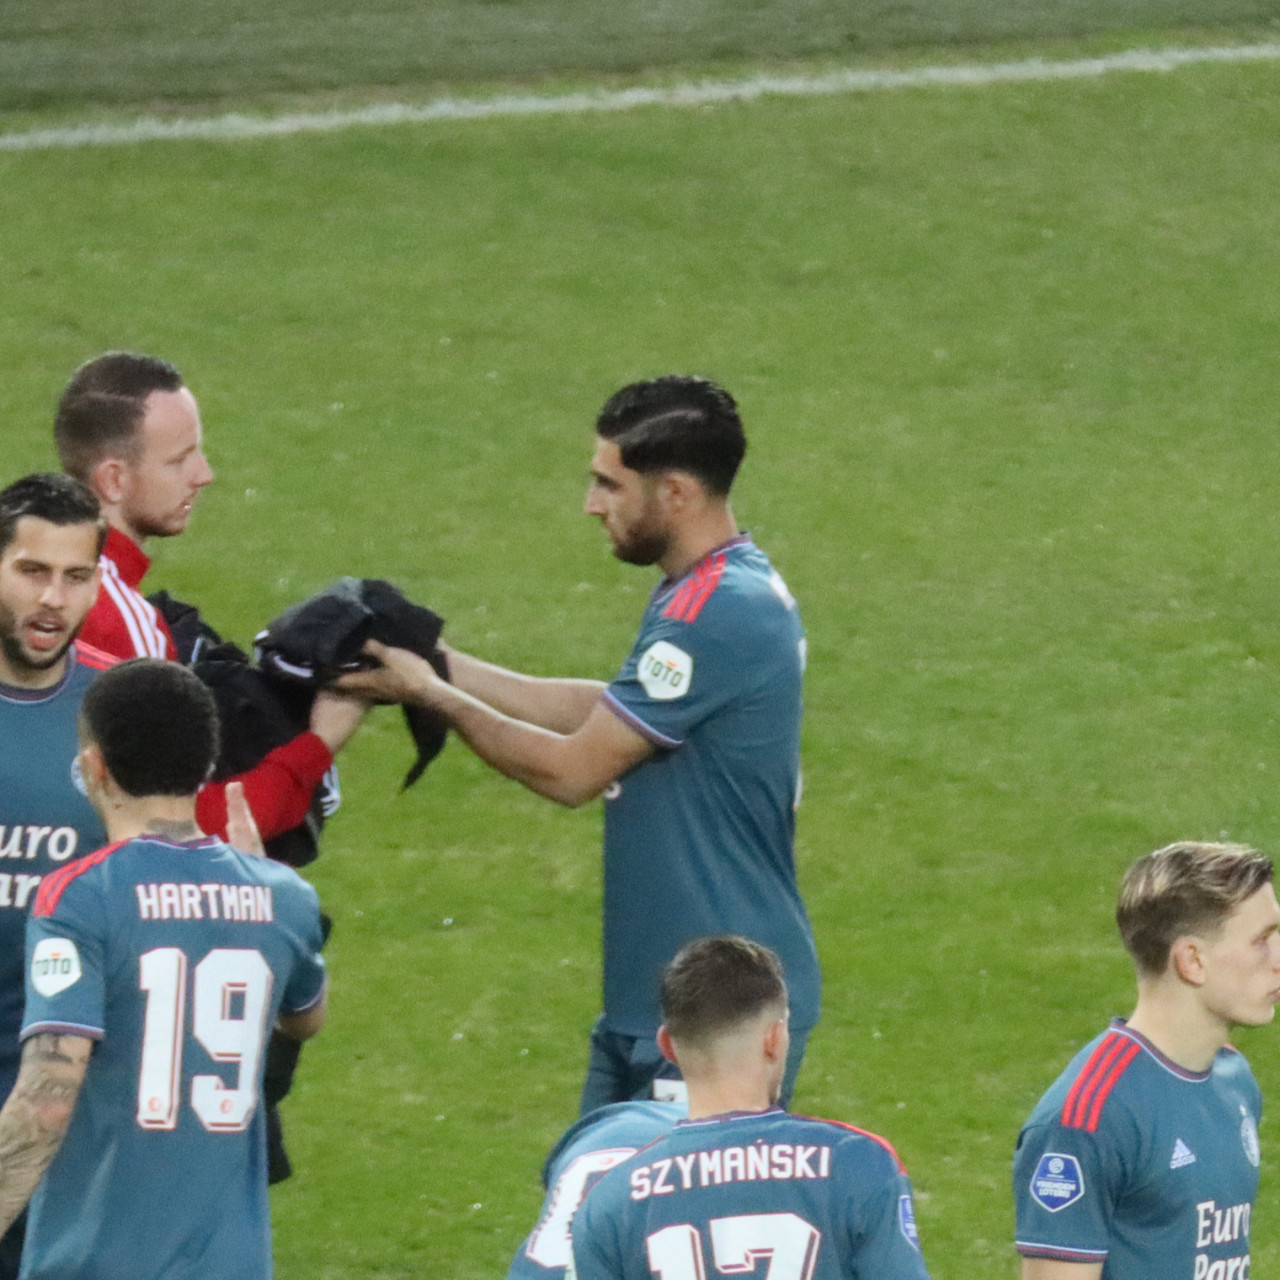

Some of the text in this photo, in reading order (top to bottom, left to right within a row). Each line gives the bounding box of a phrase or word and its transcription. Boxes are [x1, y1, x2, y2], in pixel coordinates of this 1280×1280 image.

[645, 655, 684, 687] TOTO
[135, 883, 273, 922] HARTMAN
[137, 947, 274, 1132] 19
[630, 1138, 830, 1200] SZYMAŃSKI
[1196, 1200, 1251, 1248] Euro
